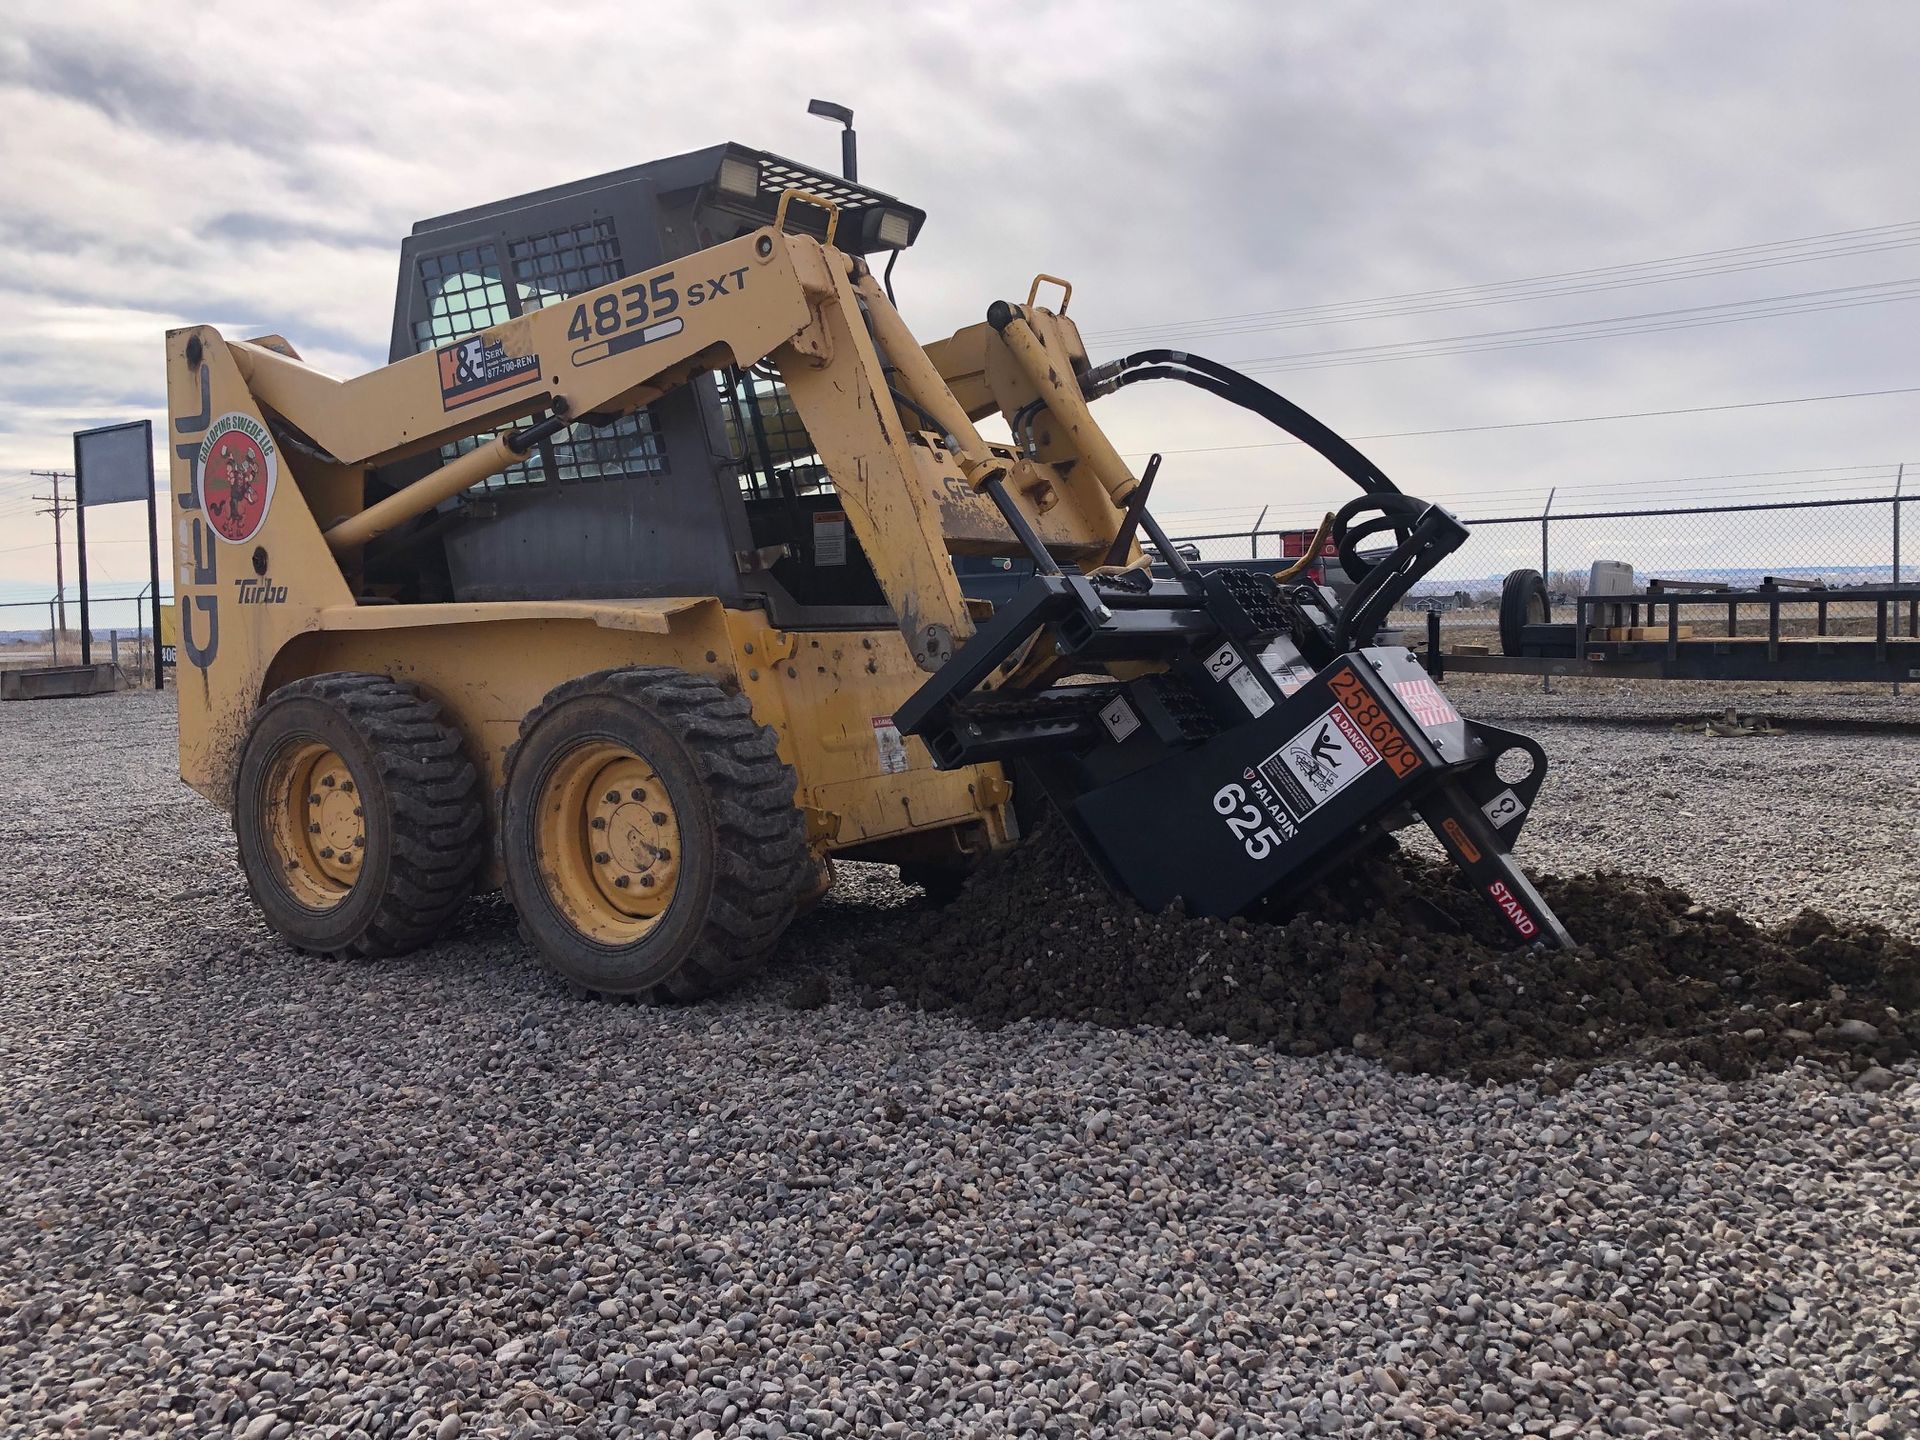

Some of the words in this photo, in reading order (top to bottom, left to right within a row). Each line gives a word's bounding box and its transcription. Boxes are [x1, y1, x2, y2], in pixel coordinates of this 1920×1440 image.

[567, 271, 680, 342] 4835
[686, 266, 750, 307] SXT
[440, 340, 485, 389] H&E
[486, 353, 537, 379] 877-700-RENT
[200, 416, 233, 464] GALLOPING
[232, 415, 264, 440] SWEDE
[259, 435, 275, 458] LLC
[235, 578, 288, 604] Turbo
[1330, 671, 1418, 776] 258609
[1339, 719, 1375, 763] DANGER
[1213, 783, 1282, 860] 625
[1250, 779, 1299, 839] PALADIN
[1489, 881, 1535, 935] STAND
